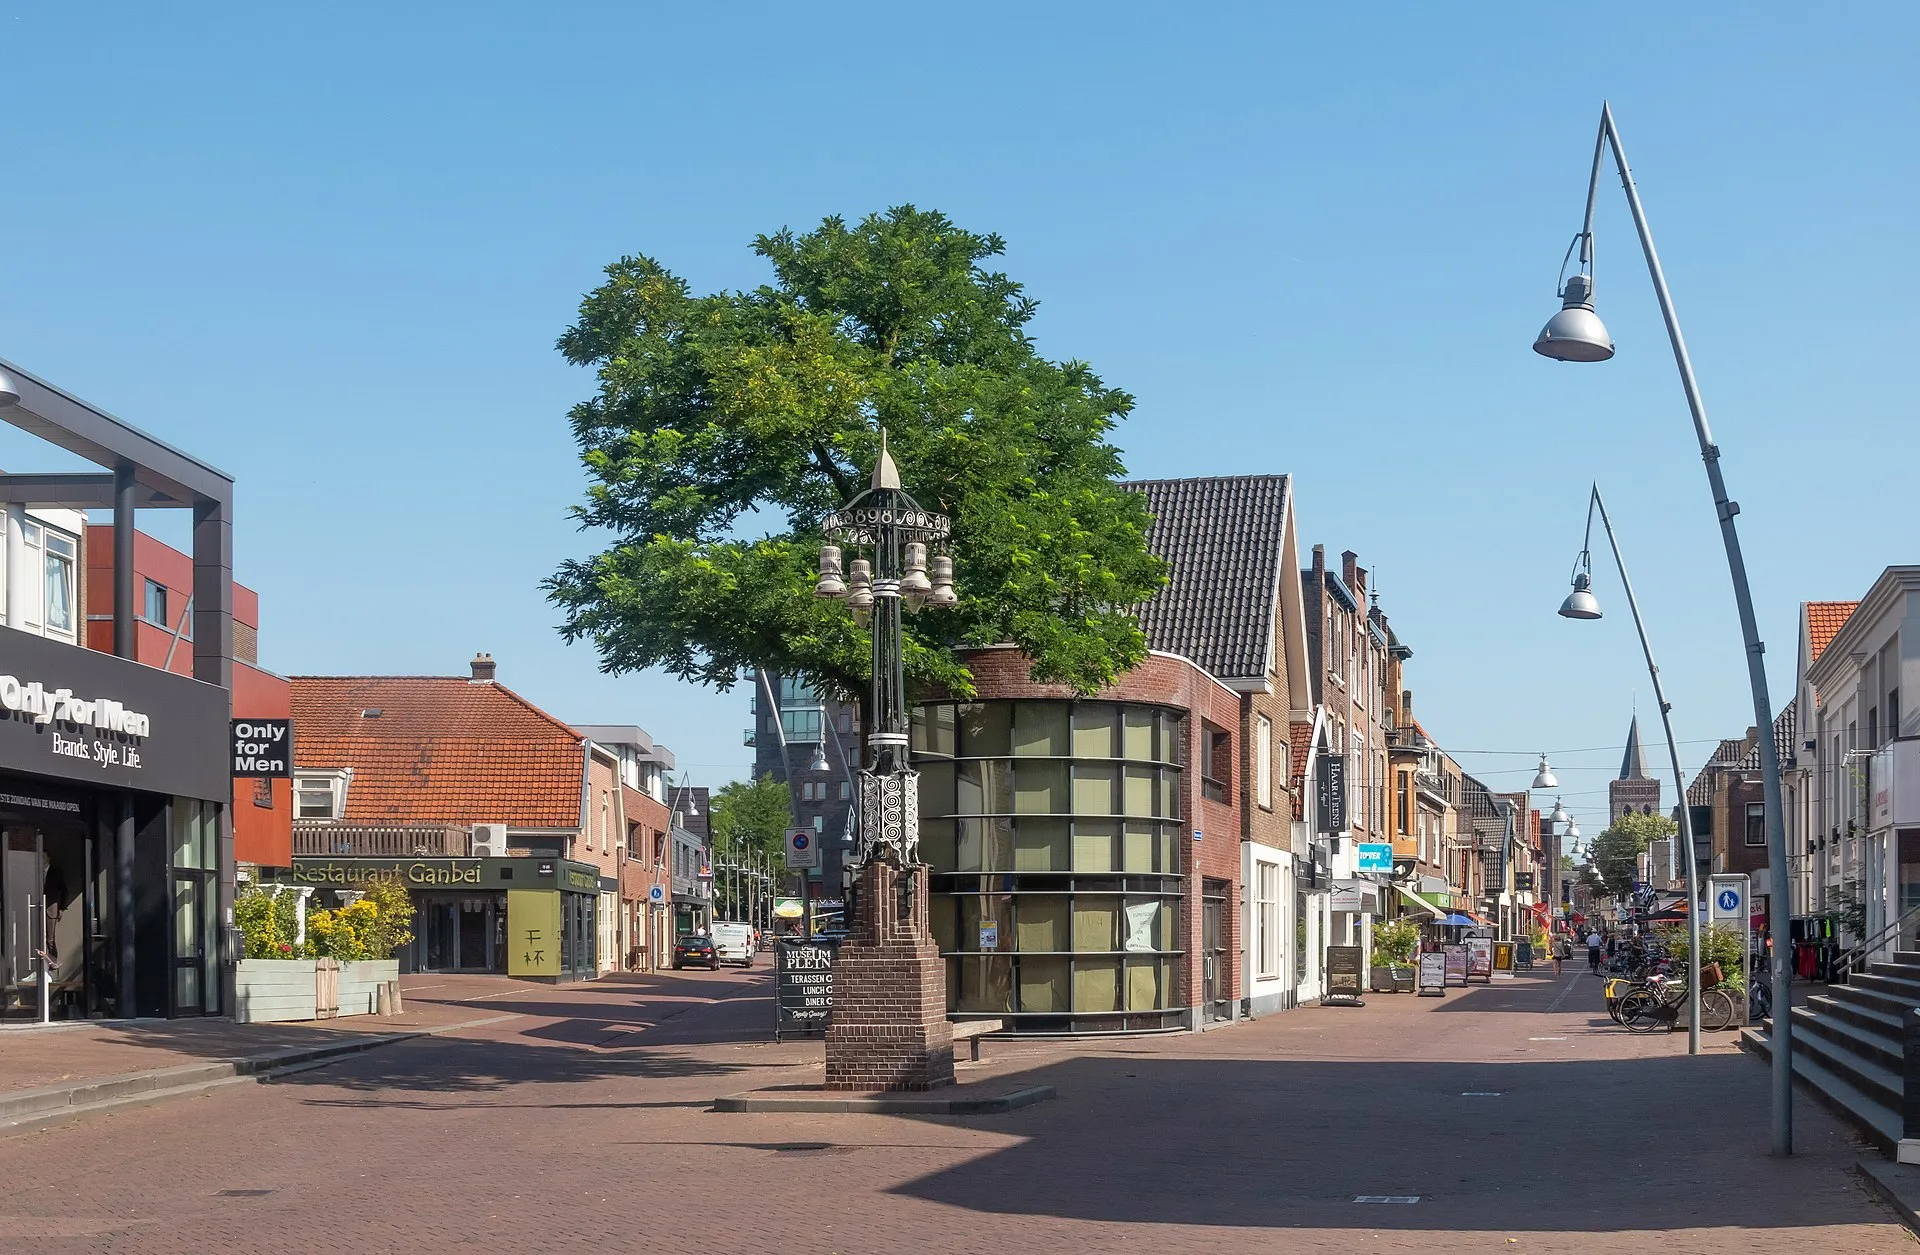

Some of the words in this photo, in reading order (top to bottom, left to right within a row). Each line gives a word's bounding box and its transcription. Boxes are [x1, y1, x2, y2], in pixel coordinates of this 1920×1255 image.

[0, 675, 57, 724] Only
[55, 688, 95, 725] for
[95, 698, 150, 737] Men
[235, 723, 286, 741] Only
[52, 732, 90, 759] Brands.
[93, 740, 120, 768] Style.
[122, 746, 142, 769] Life.
[235, 740, 270, 755] for
[235, 756, 284, 771] Men
[1331, 763, 1340, 791] HAAR
[31, 797, 42, 808] VAN
[42, 799, 49, 809] DE
[1331, 796, 1341, 827] TREND
[293, 862, 401, 884] Restaurant
[408, 861, 482, 885] Ganbei
[786, 949, 831, 961] MUSEUM
[787, 958, 831, 969] PLEIN
[791, 974, 825, 984] TERASSEN
[803, 986, 825, 995] LUNCH
[805, 997, 825, 1006] DINER
